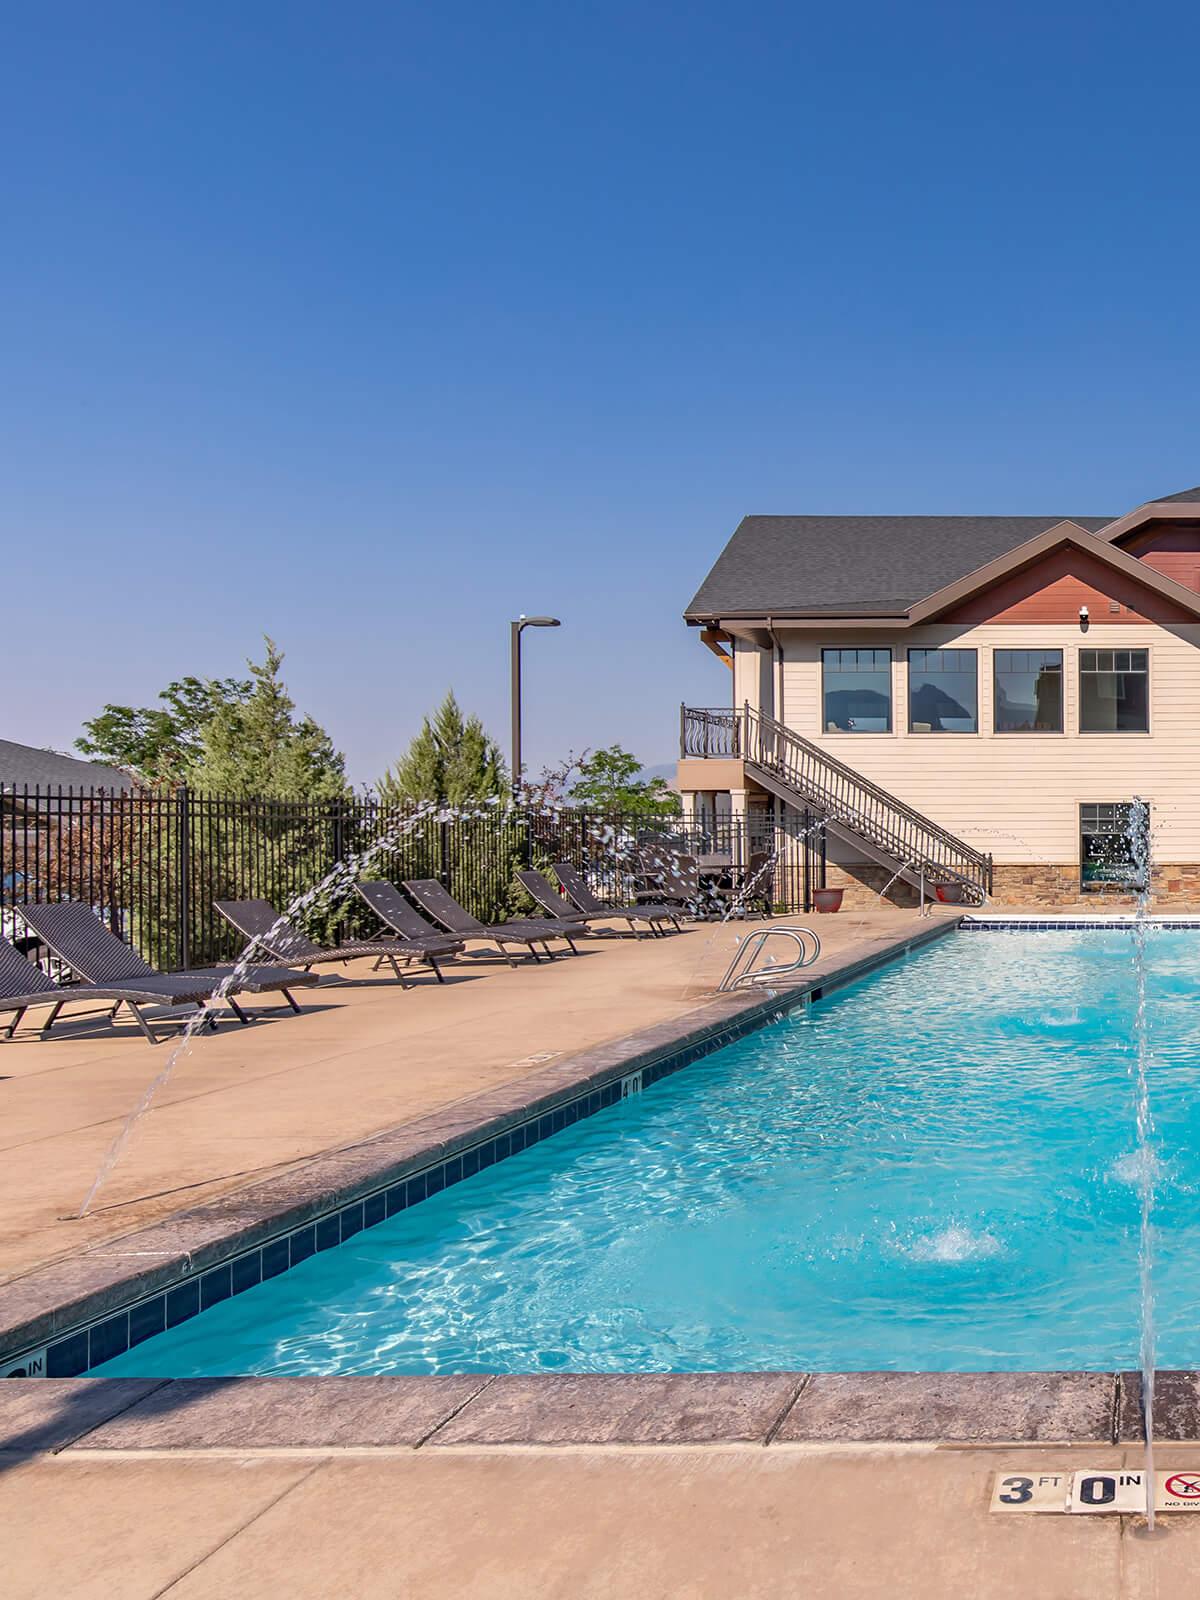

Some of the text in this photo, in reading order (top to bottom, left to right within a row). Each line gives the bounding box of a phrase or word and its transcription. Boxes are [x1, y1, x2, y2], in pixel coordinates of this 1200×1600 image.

[29, 1358, 42, 1376] IN
[999, 1475, 1141, 1504] 3 FT 0 IN
